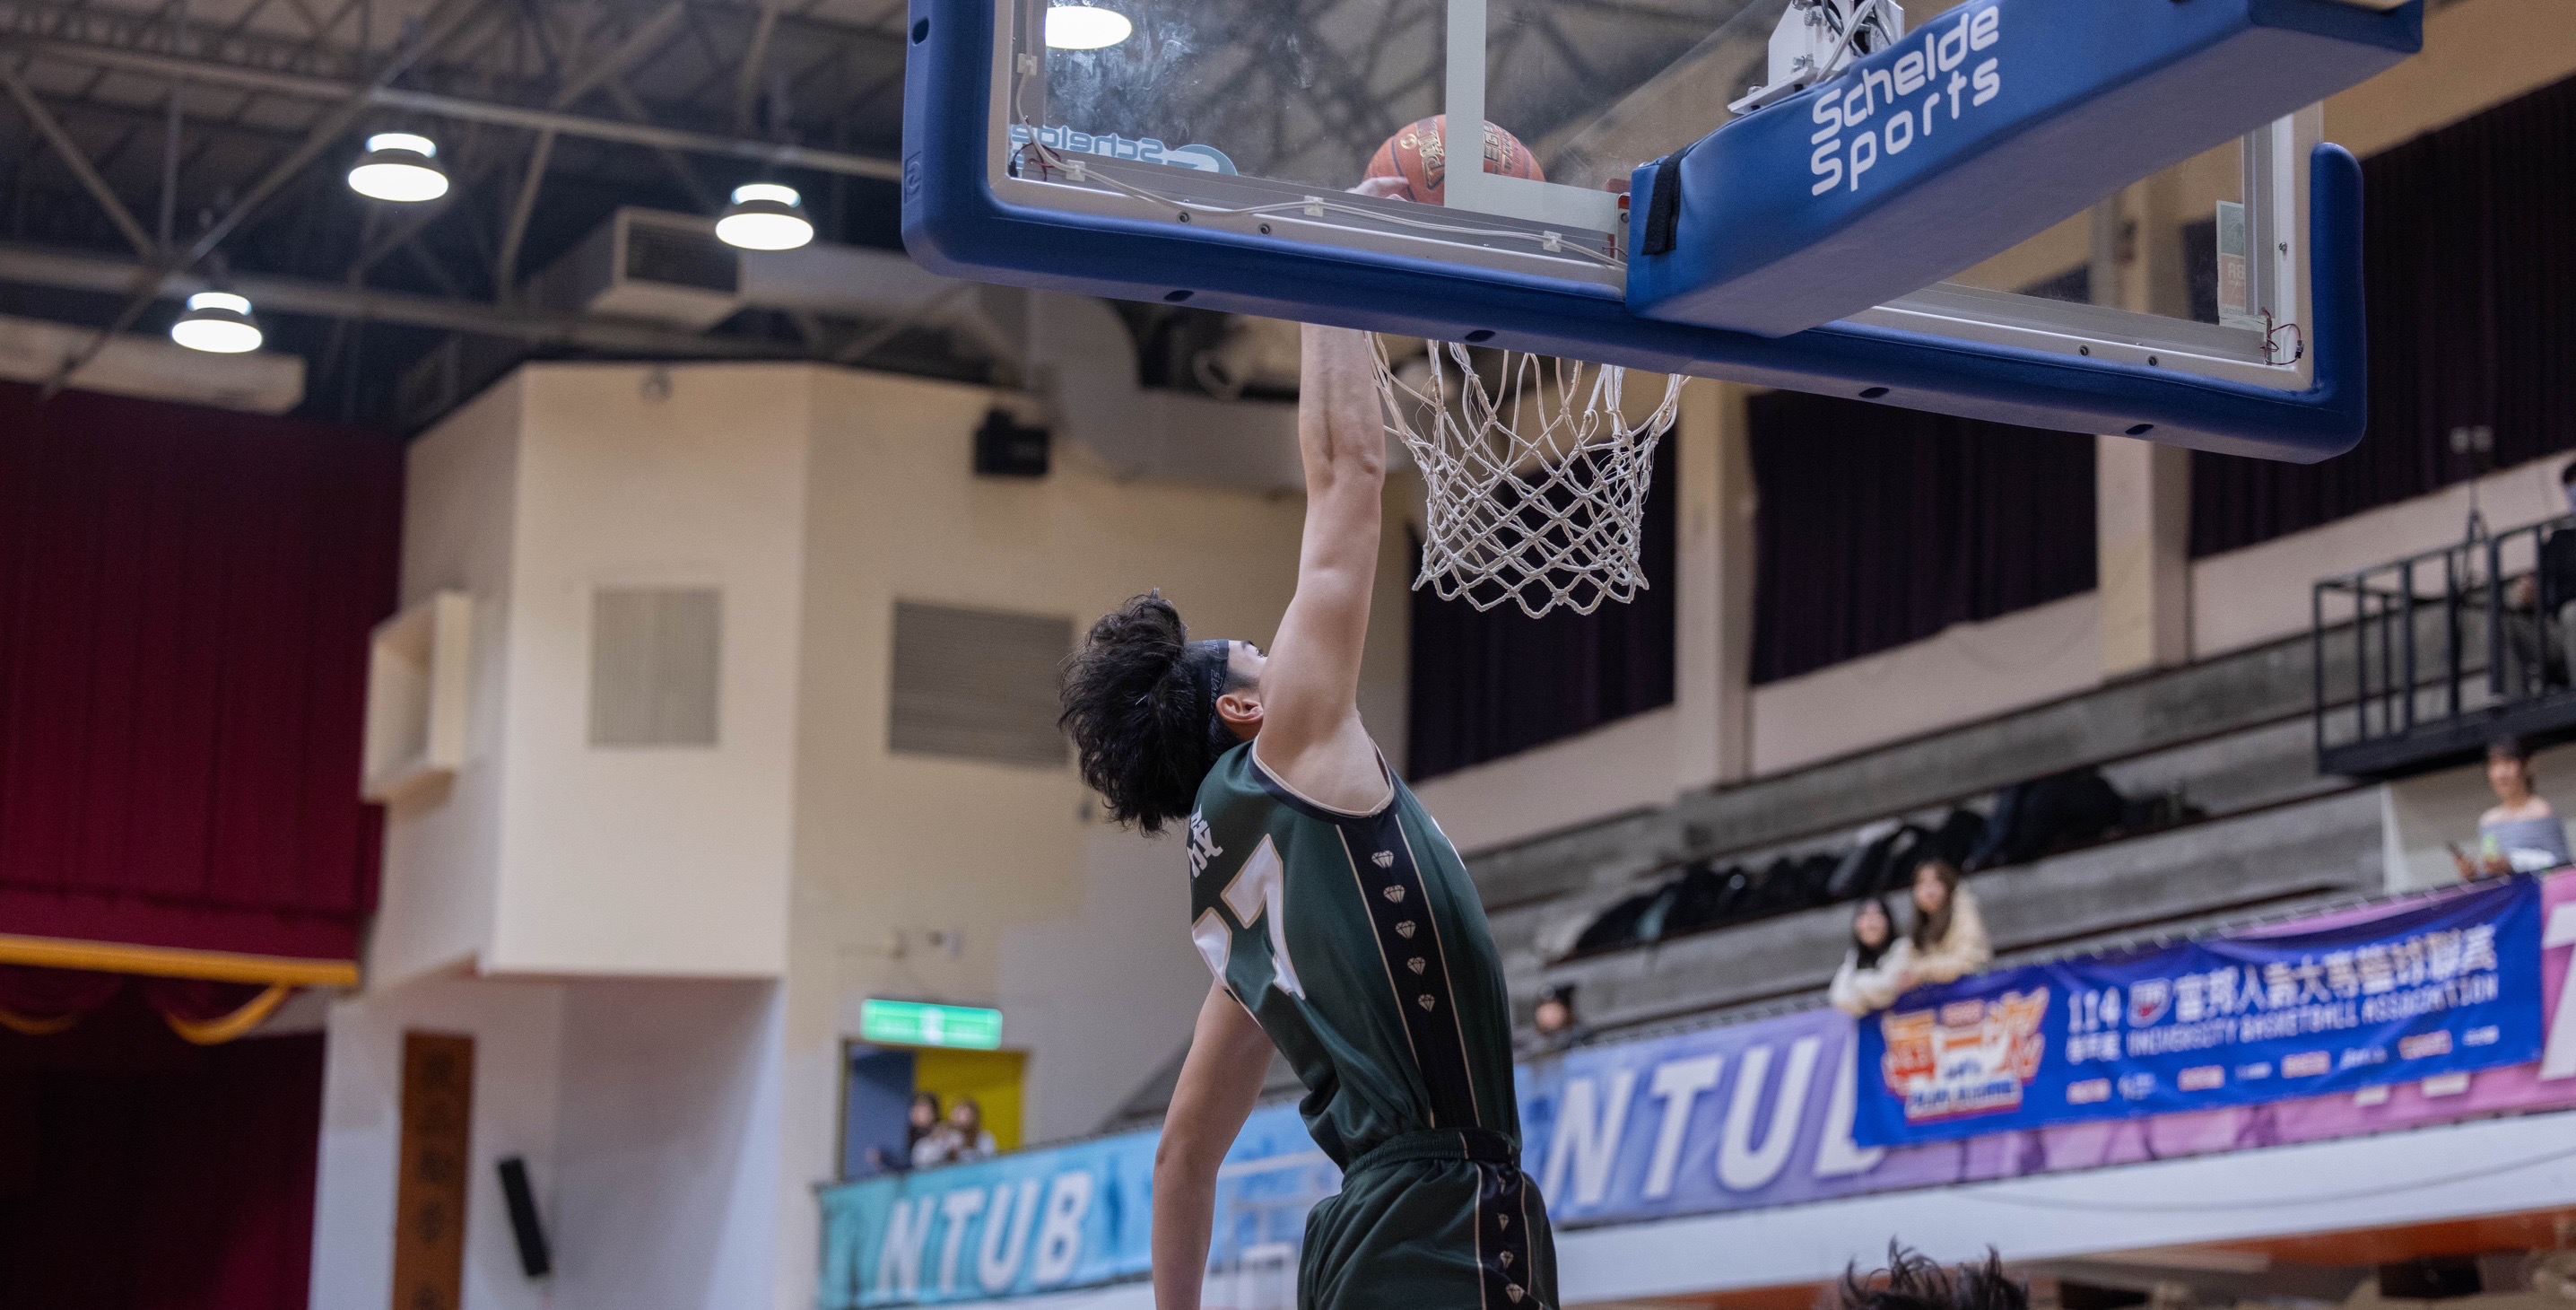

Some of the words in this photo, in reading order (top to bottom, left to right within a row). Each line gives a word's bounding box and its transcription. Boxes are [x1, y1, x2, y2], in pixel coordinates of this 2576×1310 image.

[1810, 5, 2001, 145] Schelde
[1810, 57, 2001, 196] Sports
[2067, 986, 2122, 1034] 114
[2126, 1016, 2238, 1057] UNIVERSITY
[2239, 999, 2360, 1044] BASKETBALL
[2361, 972, 2500, 1025] ASSOCIATION
[875, 1171, 1092, 1299] NTUB
